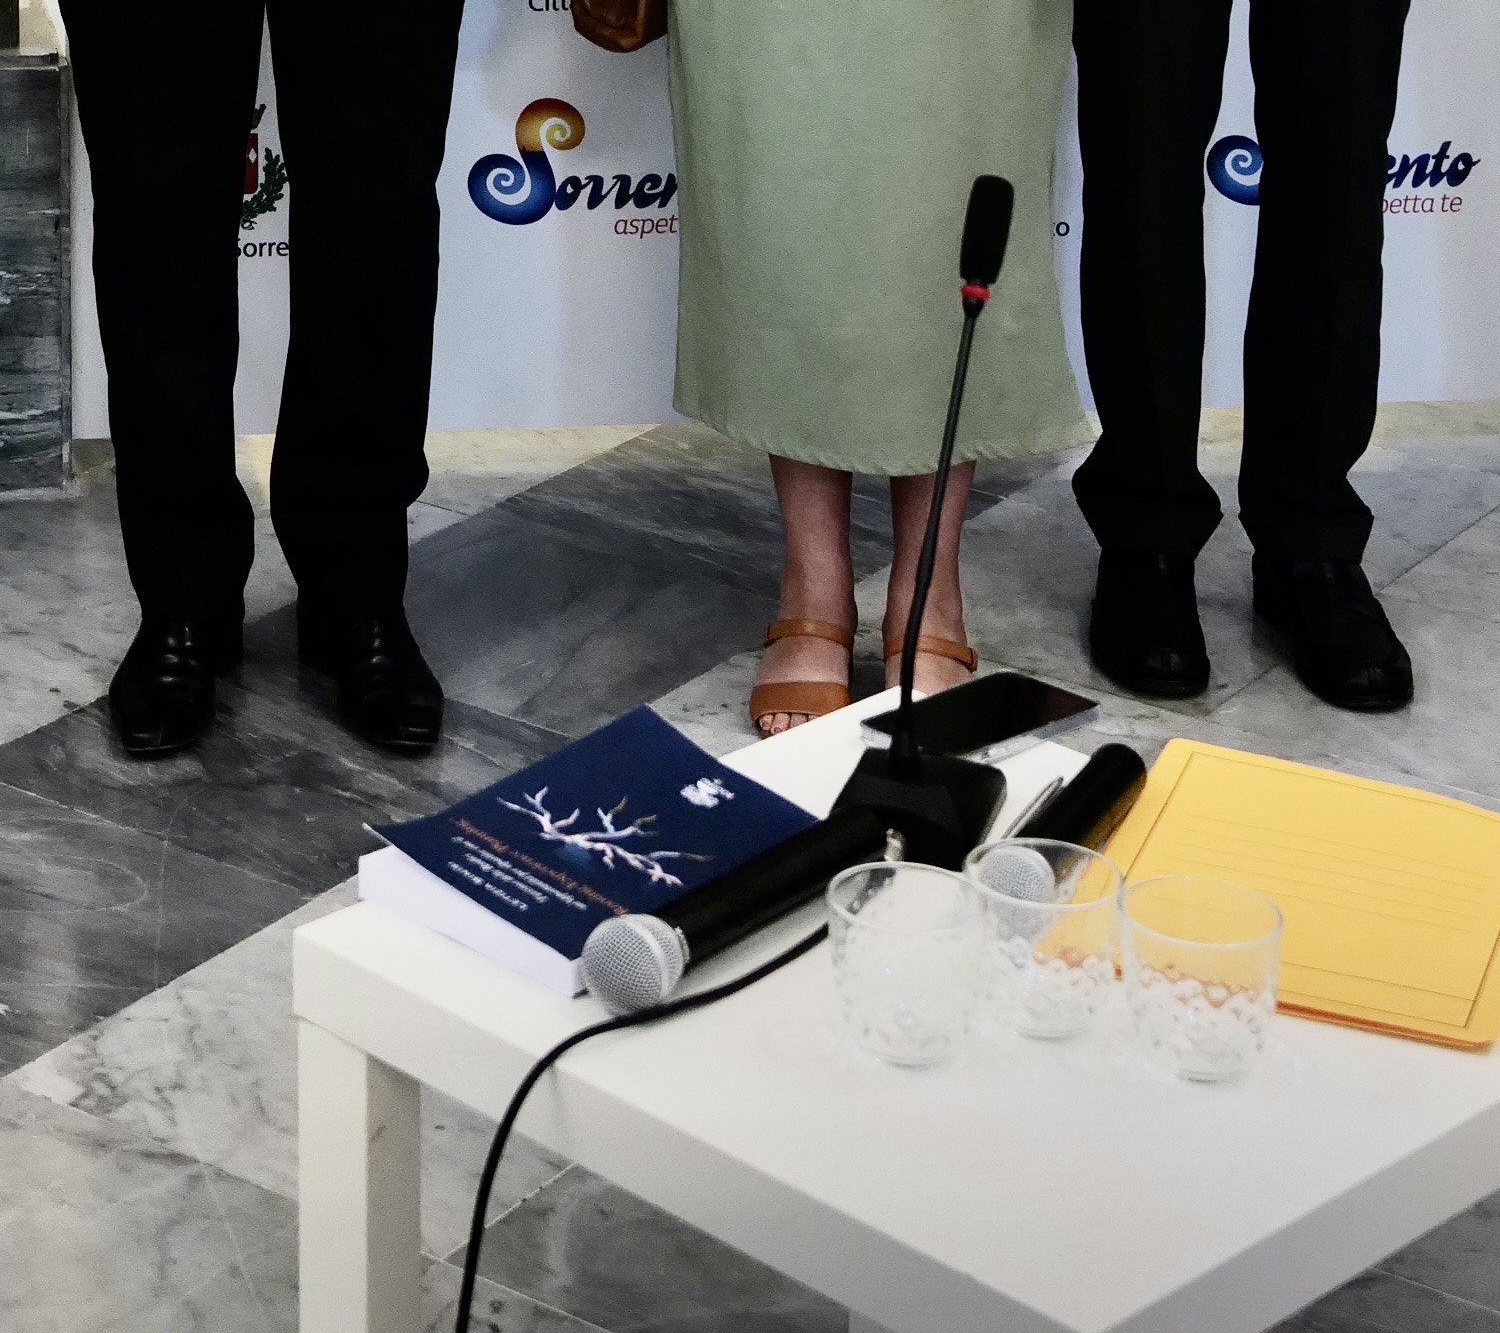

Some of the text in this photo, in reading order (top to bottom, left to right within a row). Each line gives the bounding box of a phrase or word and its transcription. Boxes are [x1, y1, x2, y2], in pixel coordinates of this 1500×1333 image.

[1387, 141, 1481, 189] ento
[1441, 194, 1462, 213] te
[614, 216, 678, 237] aspet
[237, 238, 289, 258] Sorre
